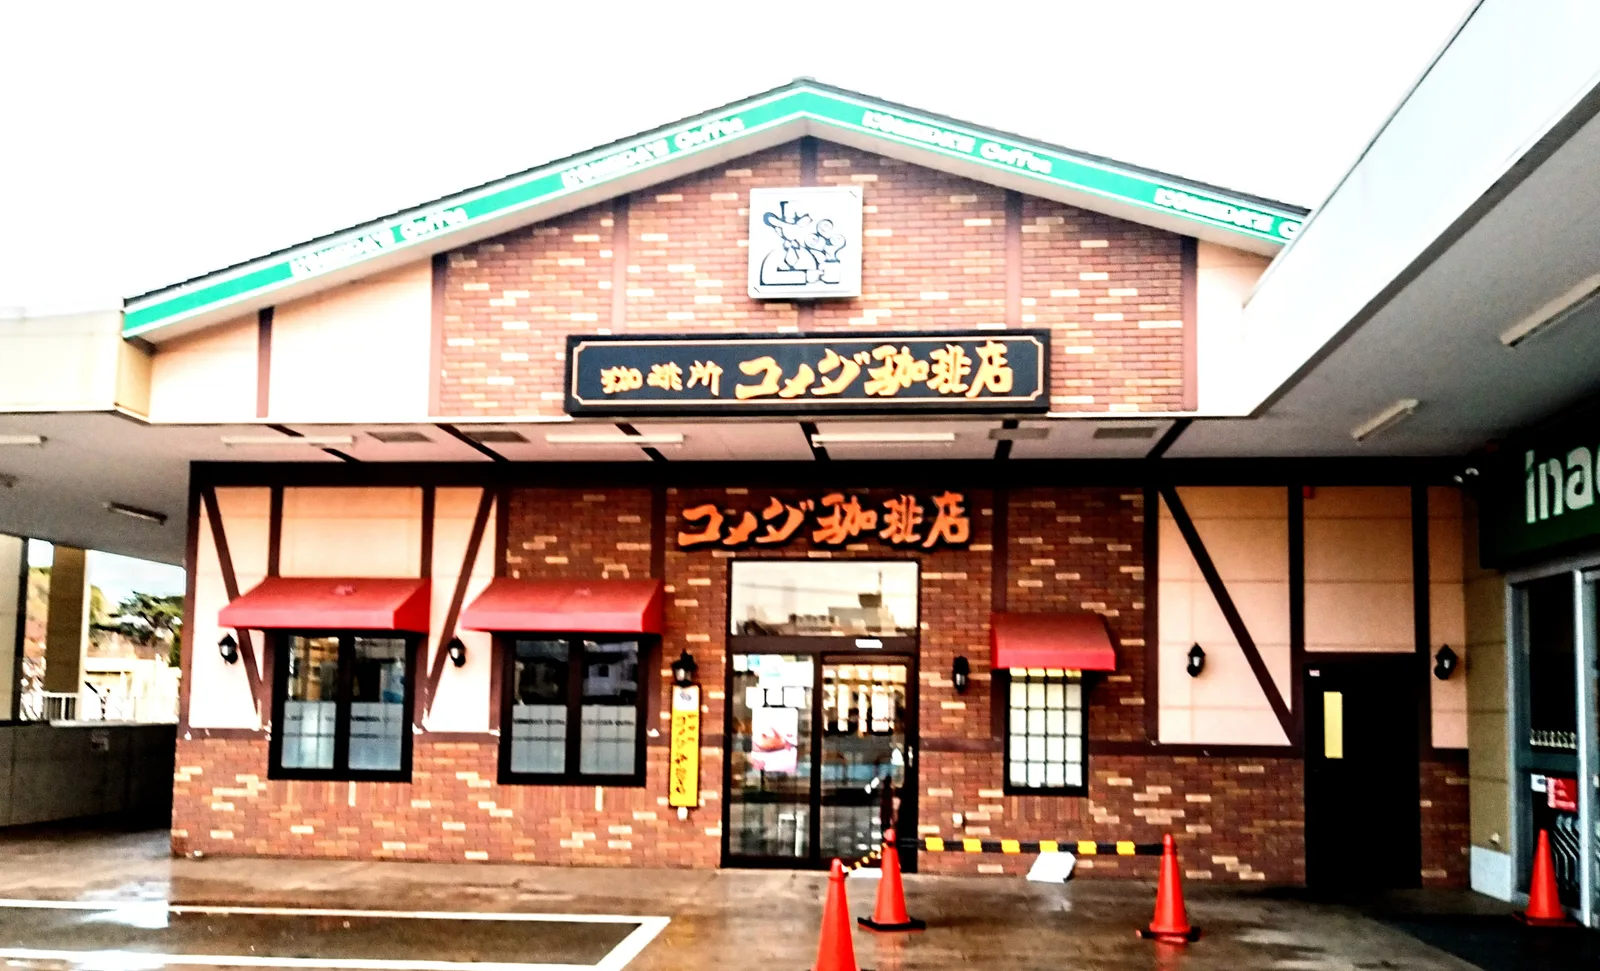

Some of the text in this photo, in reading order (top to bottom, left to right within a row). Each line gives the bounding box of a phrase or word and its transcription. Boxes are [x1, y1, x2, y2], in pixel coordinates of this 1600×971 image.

[735, 339, 1013, 399] コメダ珈琲店
[1525, 444, 1600, 524] ina
[678, 490, 969, 546] コメダ珈琲店
